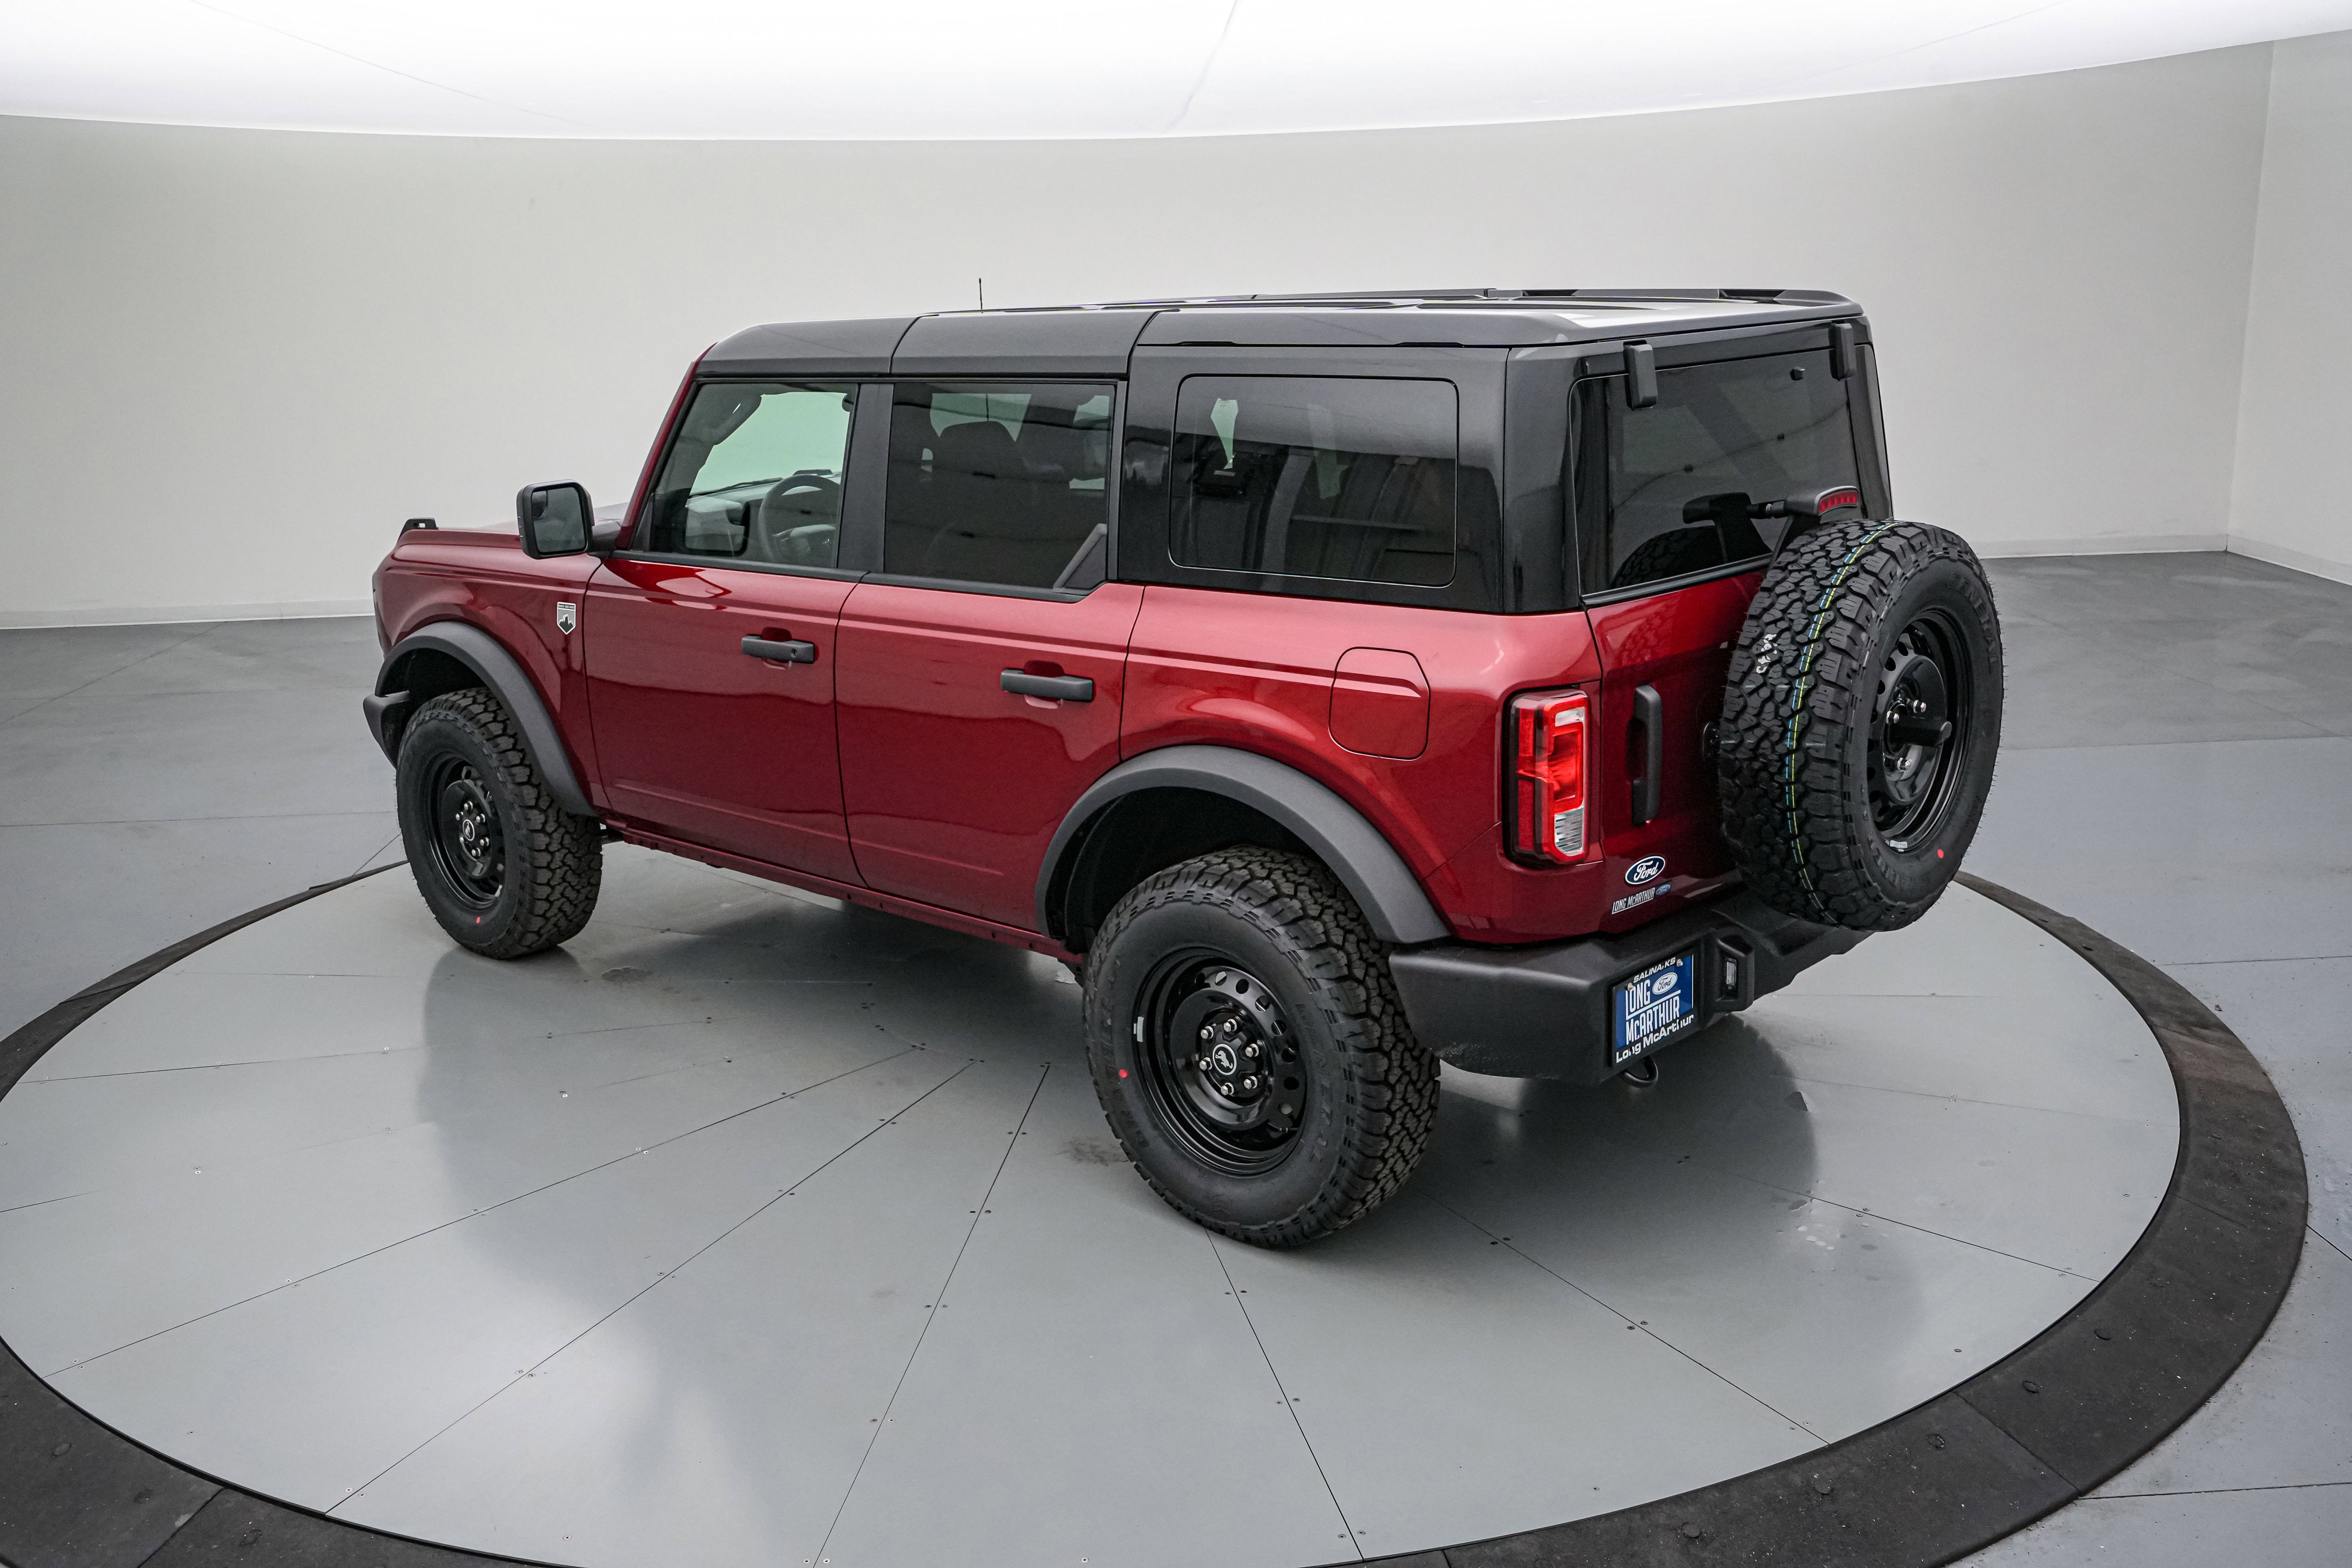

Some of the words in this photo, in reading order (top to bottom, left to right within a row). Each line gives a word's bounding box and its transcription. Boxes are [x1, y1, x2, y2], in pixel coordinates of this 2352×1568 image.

[1634, 860, 1659, 881] Ford
[1612, 898, 1626, 915] LONG
[1625, 979, 1650, 1020] LONG
[1657, 976, 1672, 991] Ford
[1616, 1042, 1641, 1063] Long
[1643, 1014, 1694, 1048] McArthur
